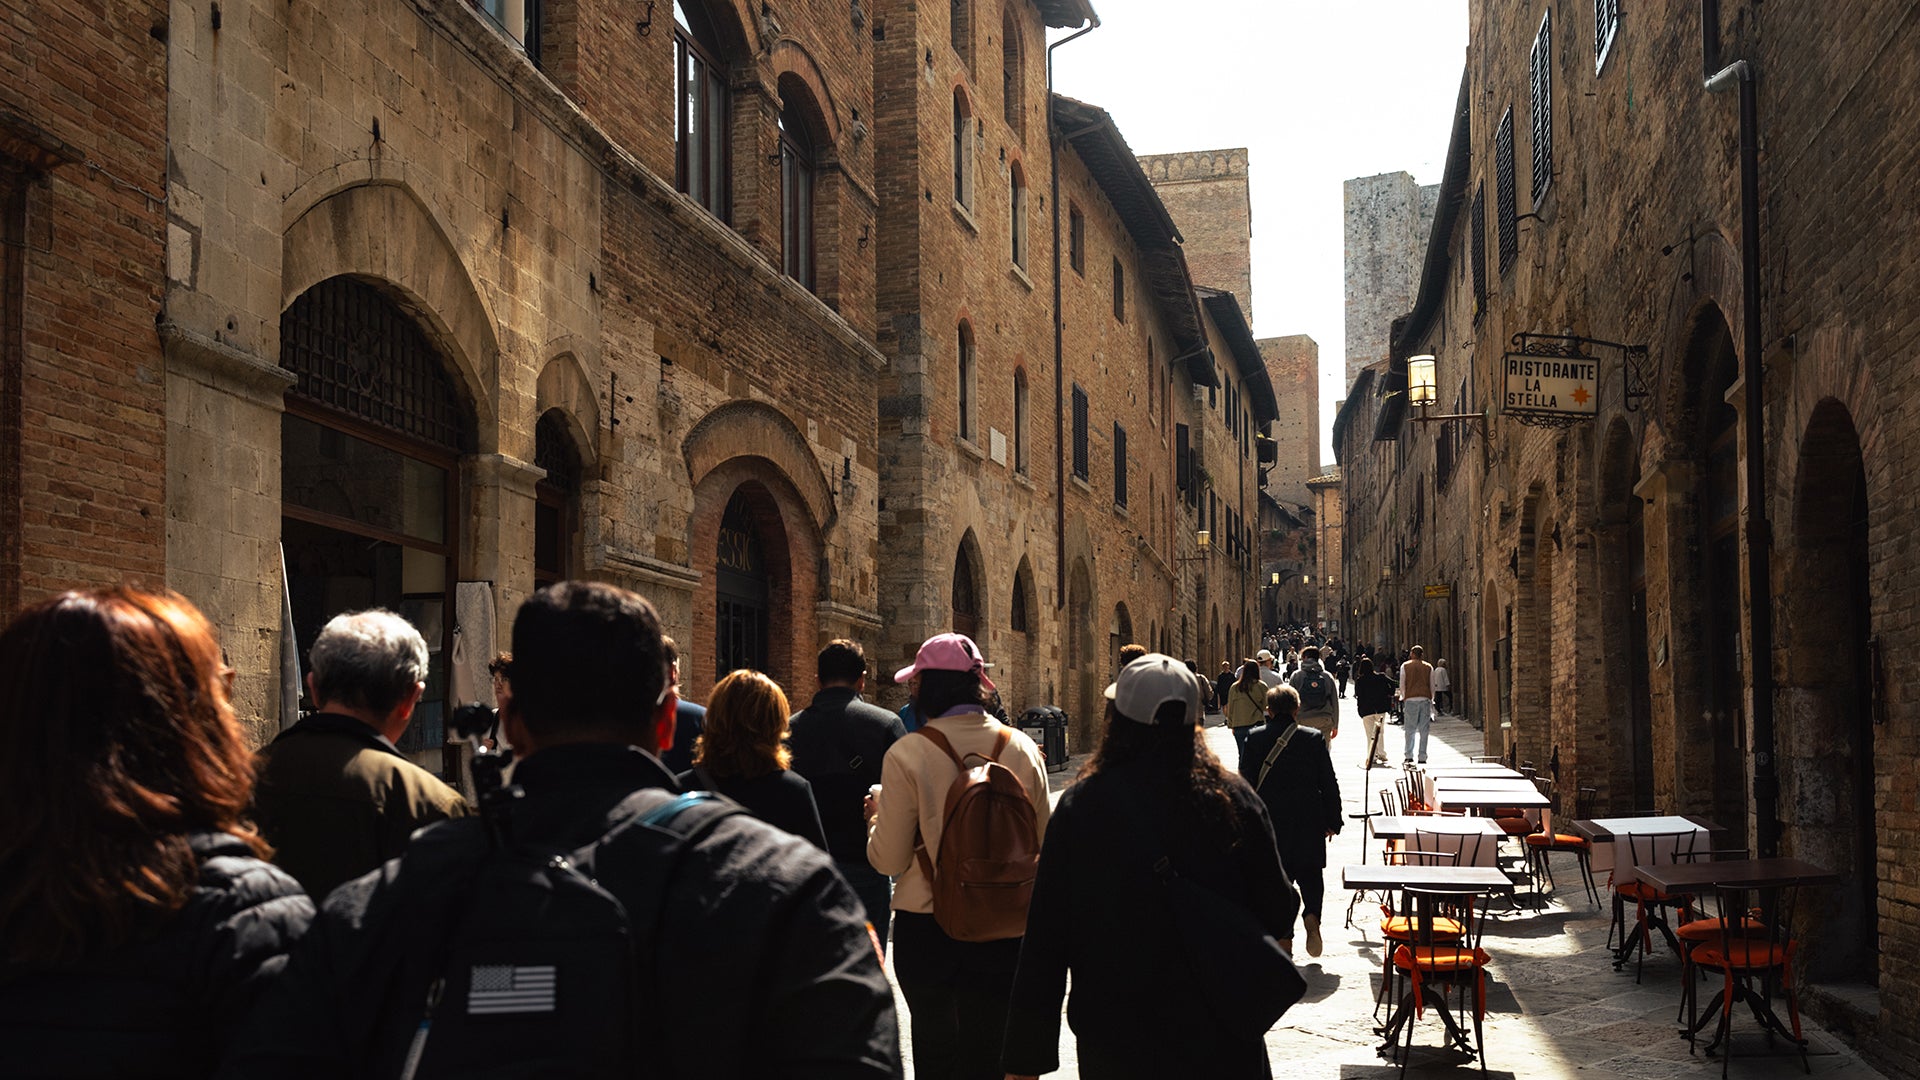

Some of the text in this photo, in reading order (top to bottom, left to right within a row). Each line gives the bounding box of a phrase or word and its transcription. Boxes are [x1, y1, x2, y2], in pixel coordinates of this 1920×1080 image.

[1509, 360, 1594, 380] RISTORANTE
[1525, 379, 1541, 392] LA
[1508, 393, 1557, 408] STELLA
